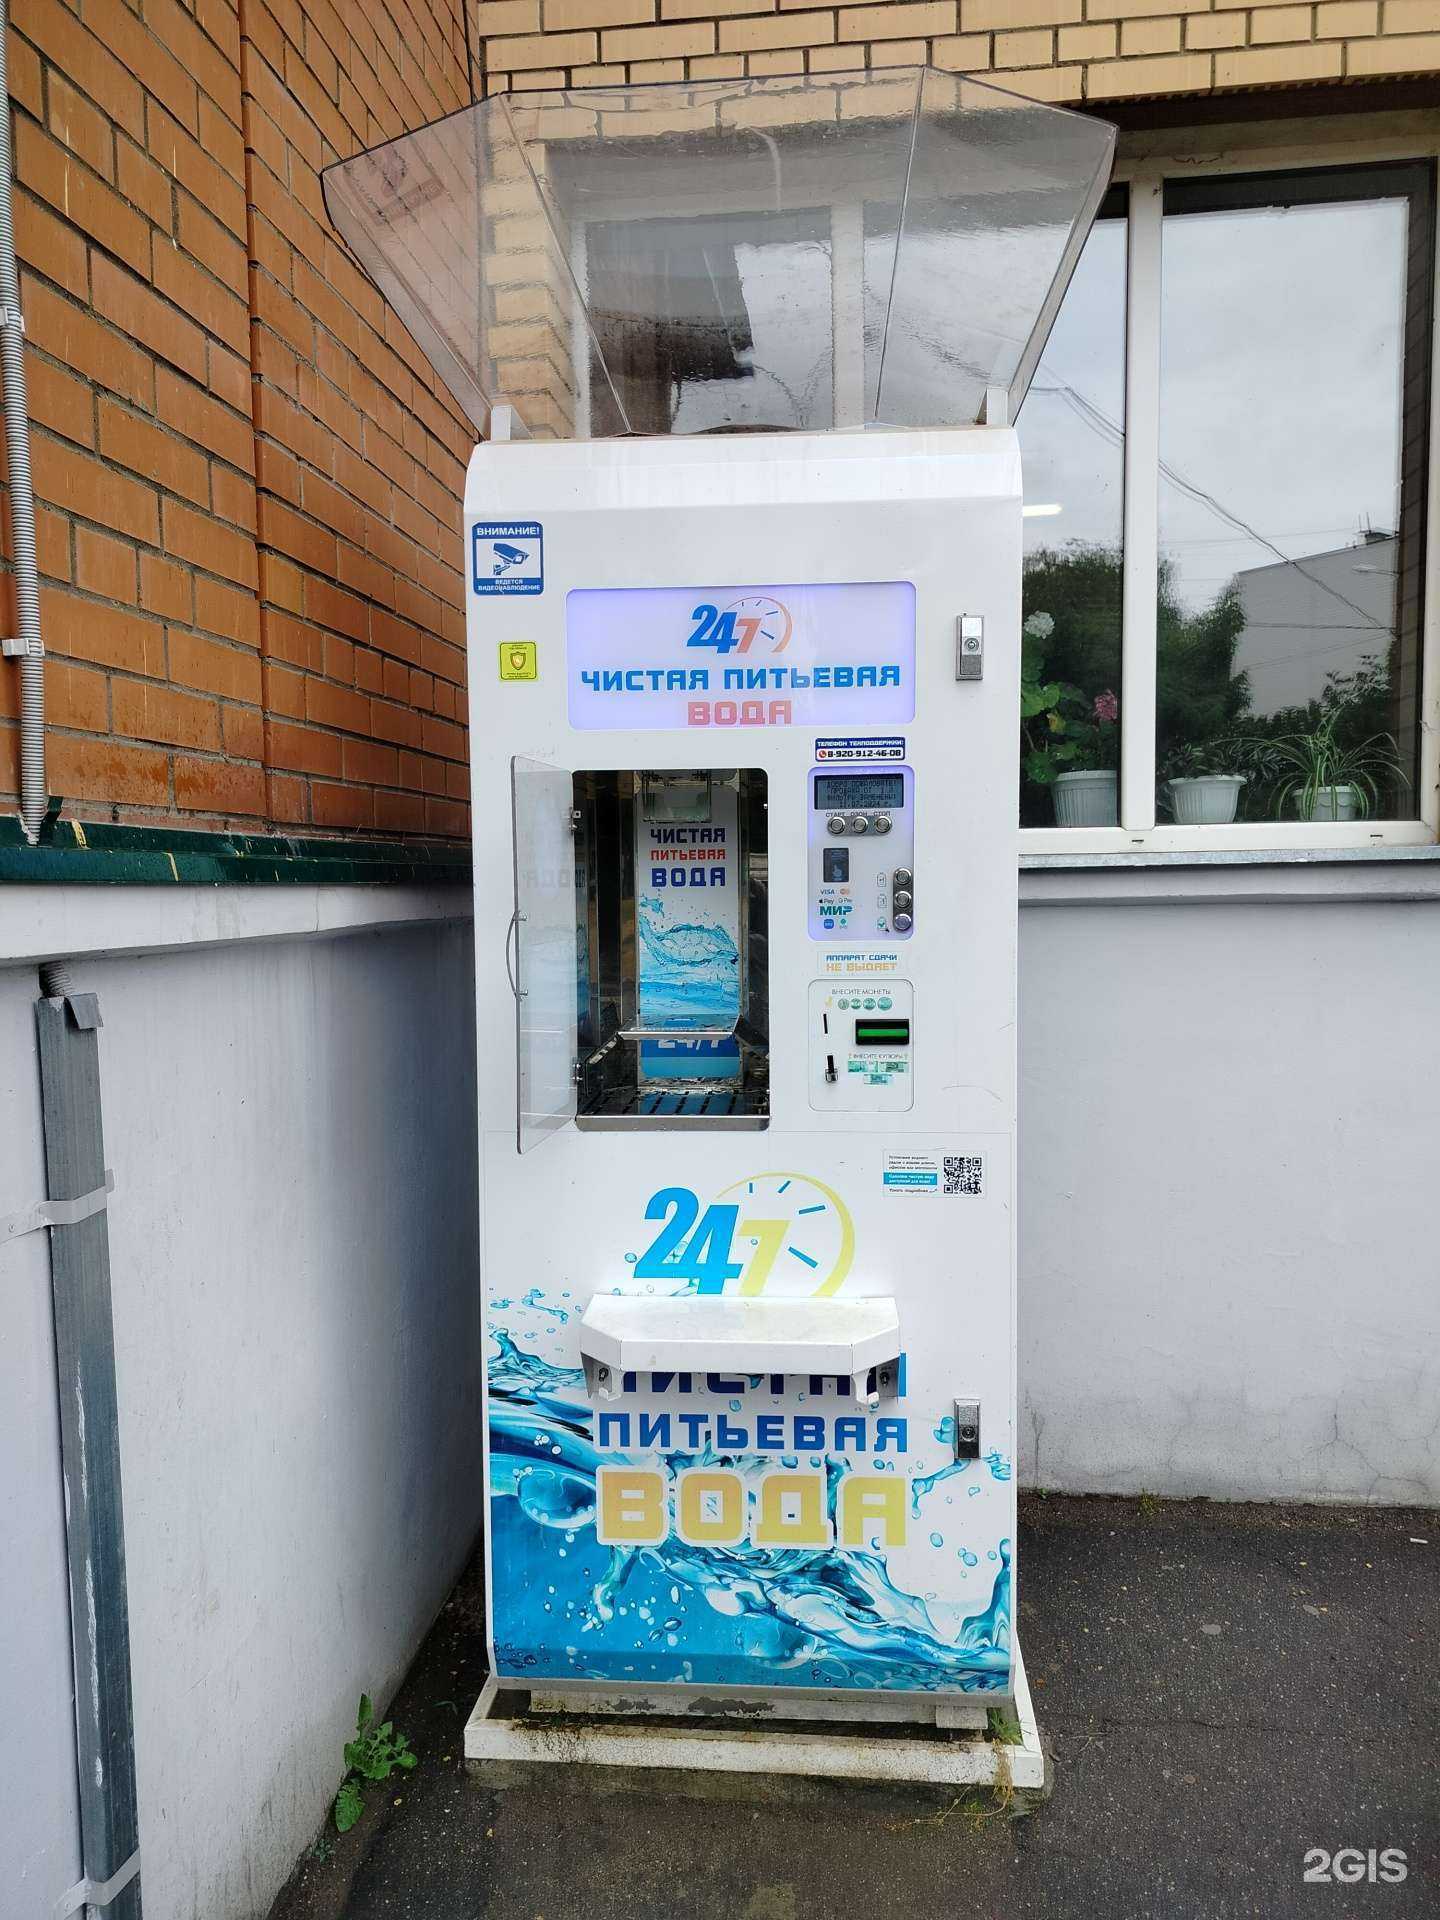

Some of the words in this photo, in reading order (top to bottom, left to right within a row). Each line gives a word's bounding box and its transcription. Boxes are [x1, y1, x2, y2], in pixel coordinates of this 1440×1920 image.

[477, 527, 540, 536] ВНИМАНИЕ!
[581, 668, 709, 692] ЧИСТАЯ
[724, 665, 900, 690] ПИТЬЕВАЯ
[688, 700, 792, 726] ВОДА
[828, 749, 901, 757] 8-920-912-46-08
[650, 827, 726, 845] ЧИСТАЯ
[650, 848, 726, 862] ПИТЬЕВАЯ
[651, 866, 726, 888] ВОДА
[819, 905, 853, 916] МИР
[826, 963, 842, 971] НЕ
[847, 962, 898, 971] ВЫДАЕТ
[598, 1412, 908, 1453] ПИТЬЕВАЯ
[601, 1471, 907, 1547] ВОДА
